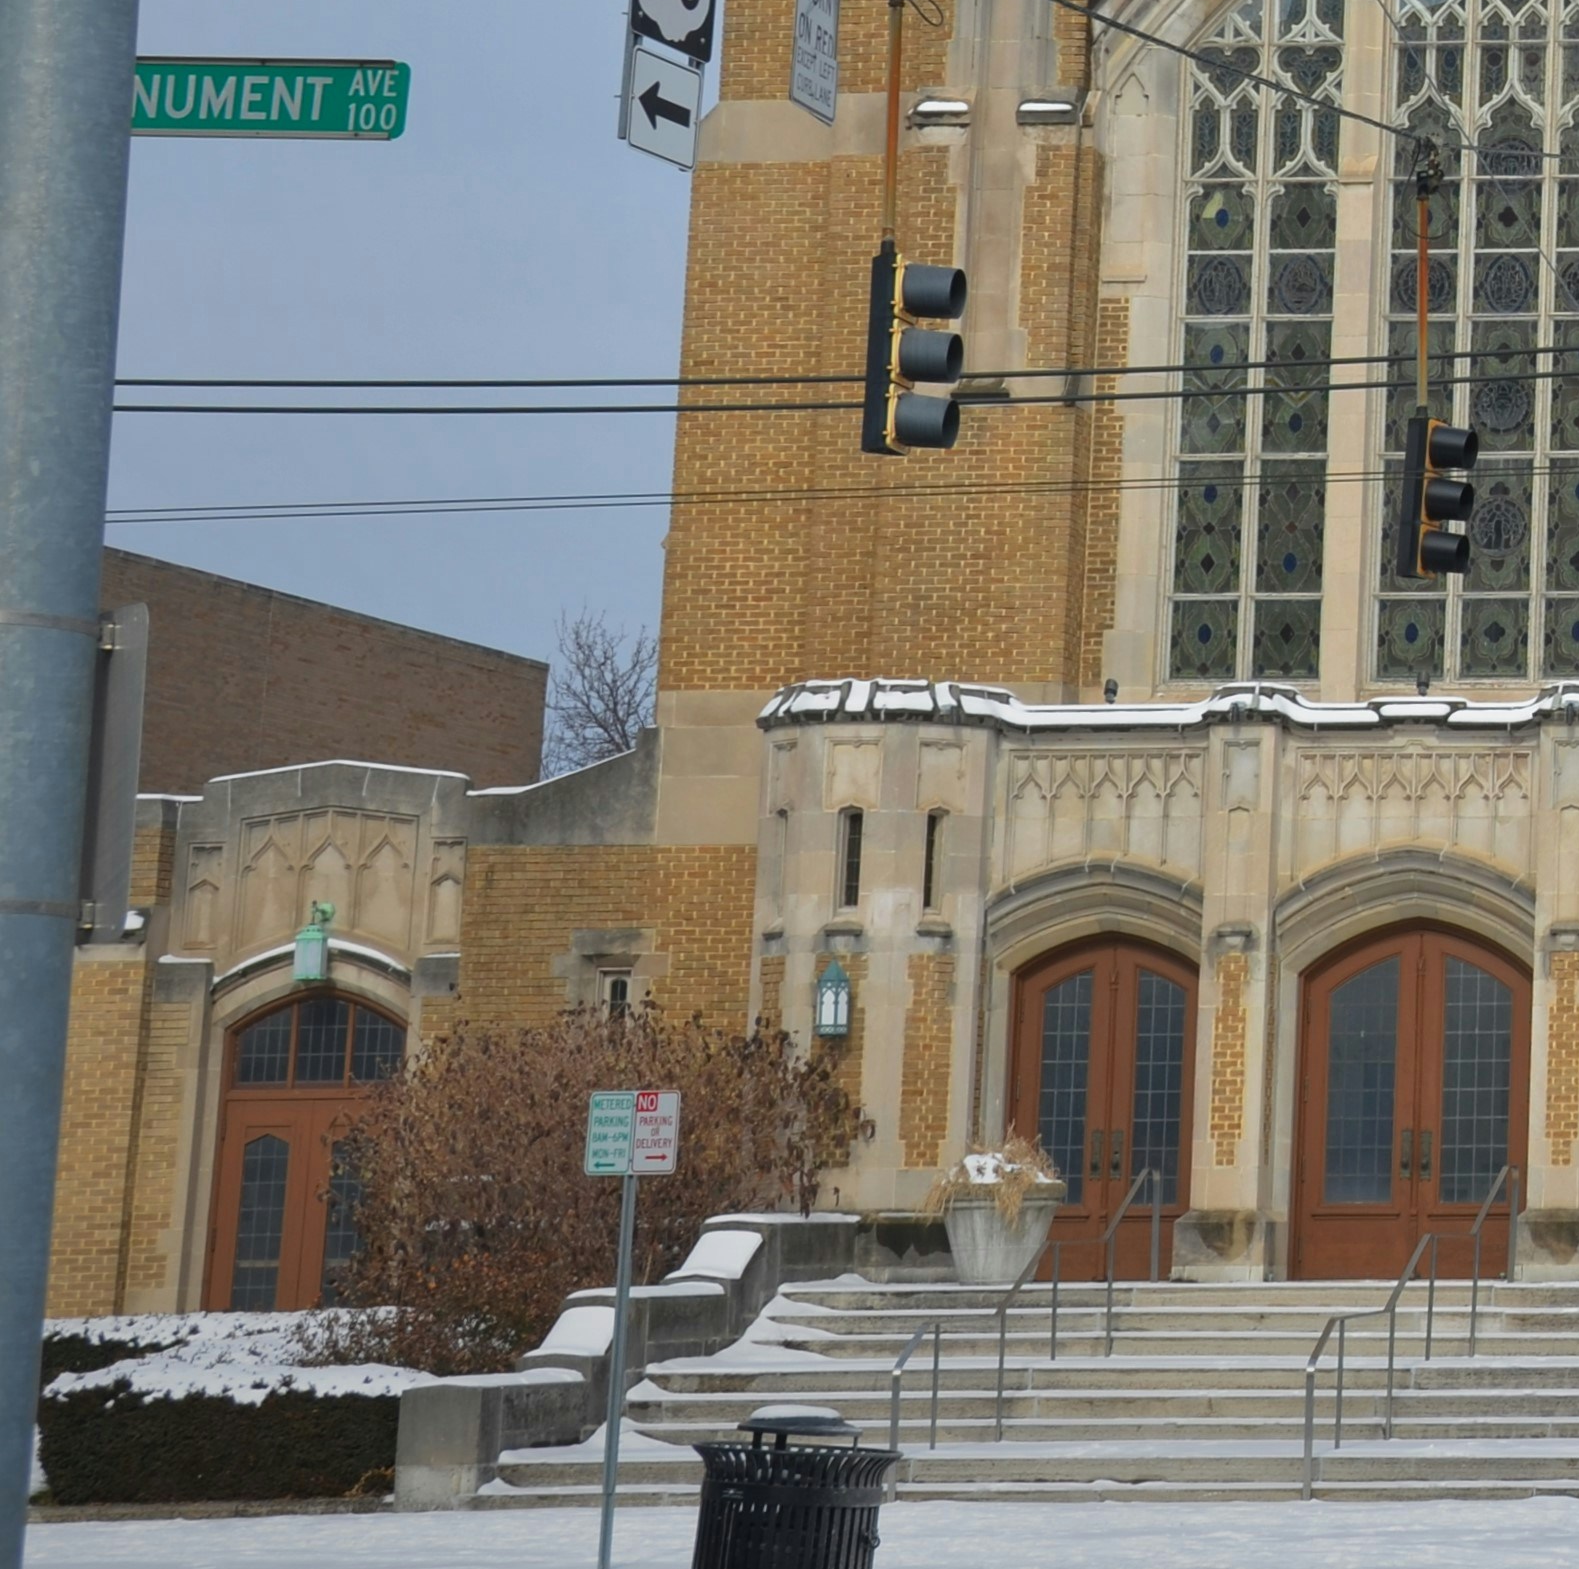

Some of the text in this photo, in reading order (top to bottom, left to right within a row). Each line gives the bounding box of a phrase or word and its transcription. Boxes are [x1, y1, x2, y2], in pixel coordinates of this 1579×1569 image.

[798, 13, 833, 59] ON RED
[797, 46, 836, 84] EXCEPT LEFT
[348, 69, 399, 97] AVE
[347, 103, 397, 131] 100
[593, 1098, 632, 1110] METERED
[637, 1095, 657, 1111] NO
[593, 1116, 630, 1127] PARKING
[639, 1116, 673, 1126] PARKING
[635, 1137, 673, 1149] DELIVERY
